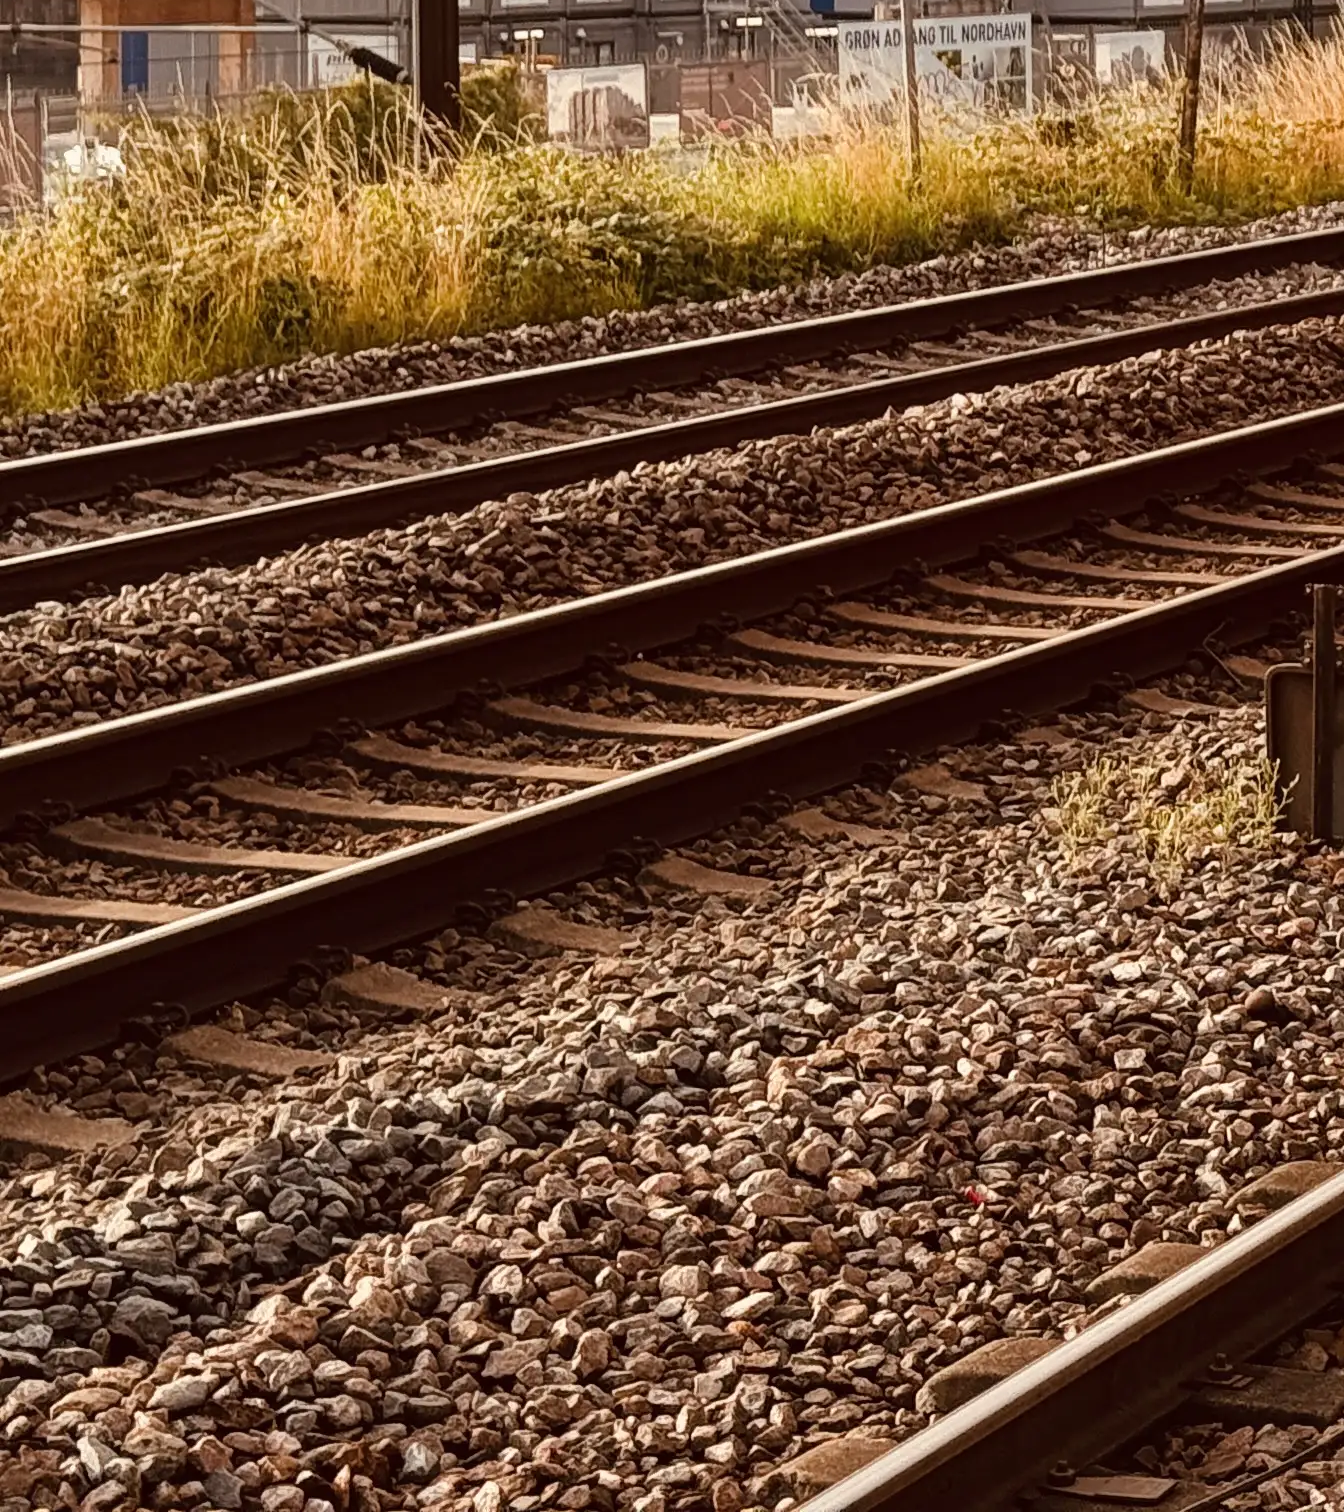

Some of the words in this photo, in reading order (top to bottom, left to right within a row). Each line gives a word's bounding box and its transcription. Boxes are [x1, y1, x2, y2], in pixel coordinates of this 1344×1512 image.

[845, 28, 880, 50] GRØN
[884, 25, 936, 49] ADANG
[939, 24, 958, 44] TIL
[961, 20, 1026, 42] NORDHAVN
